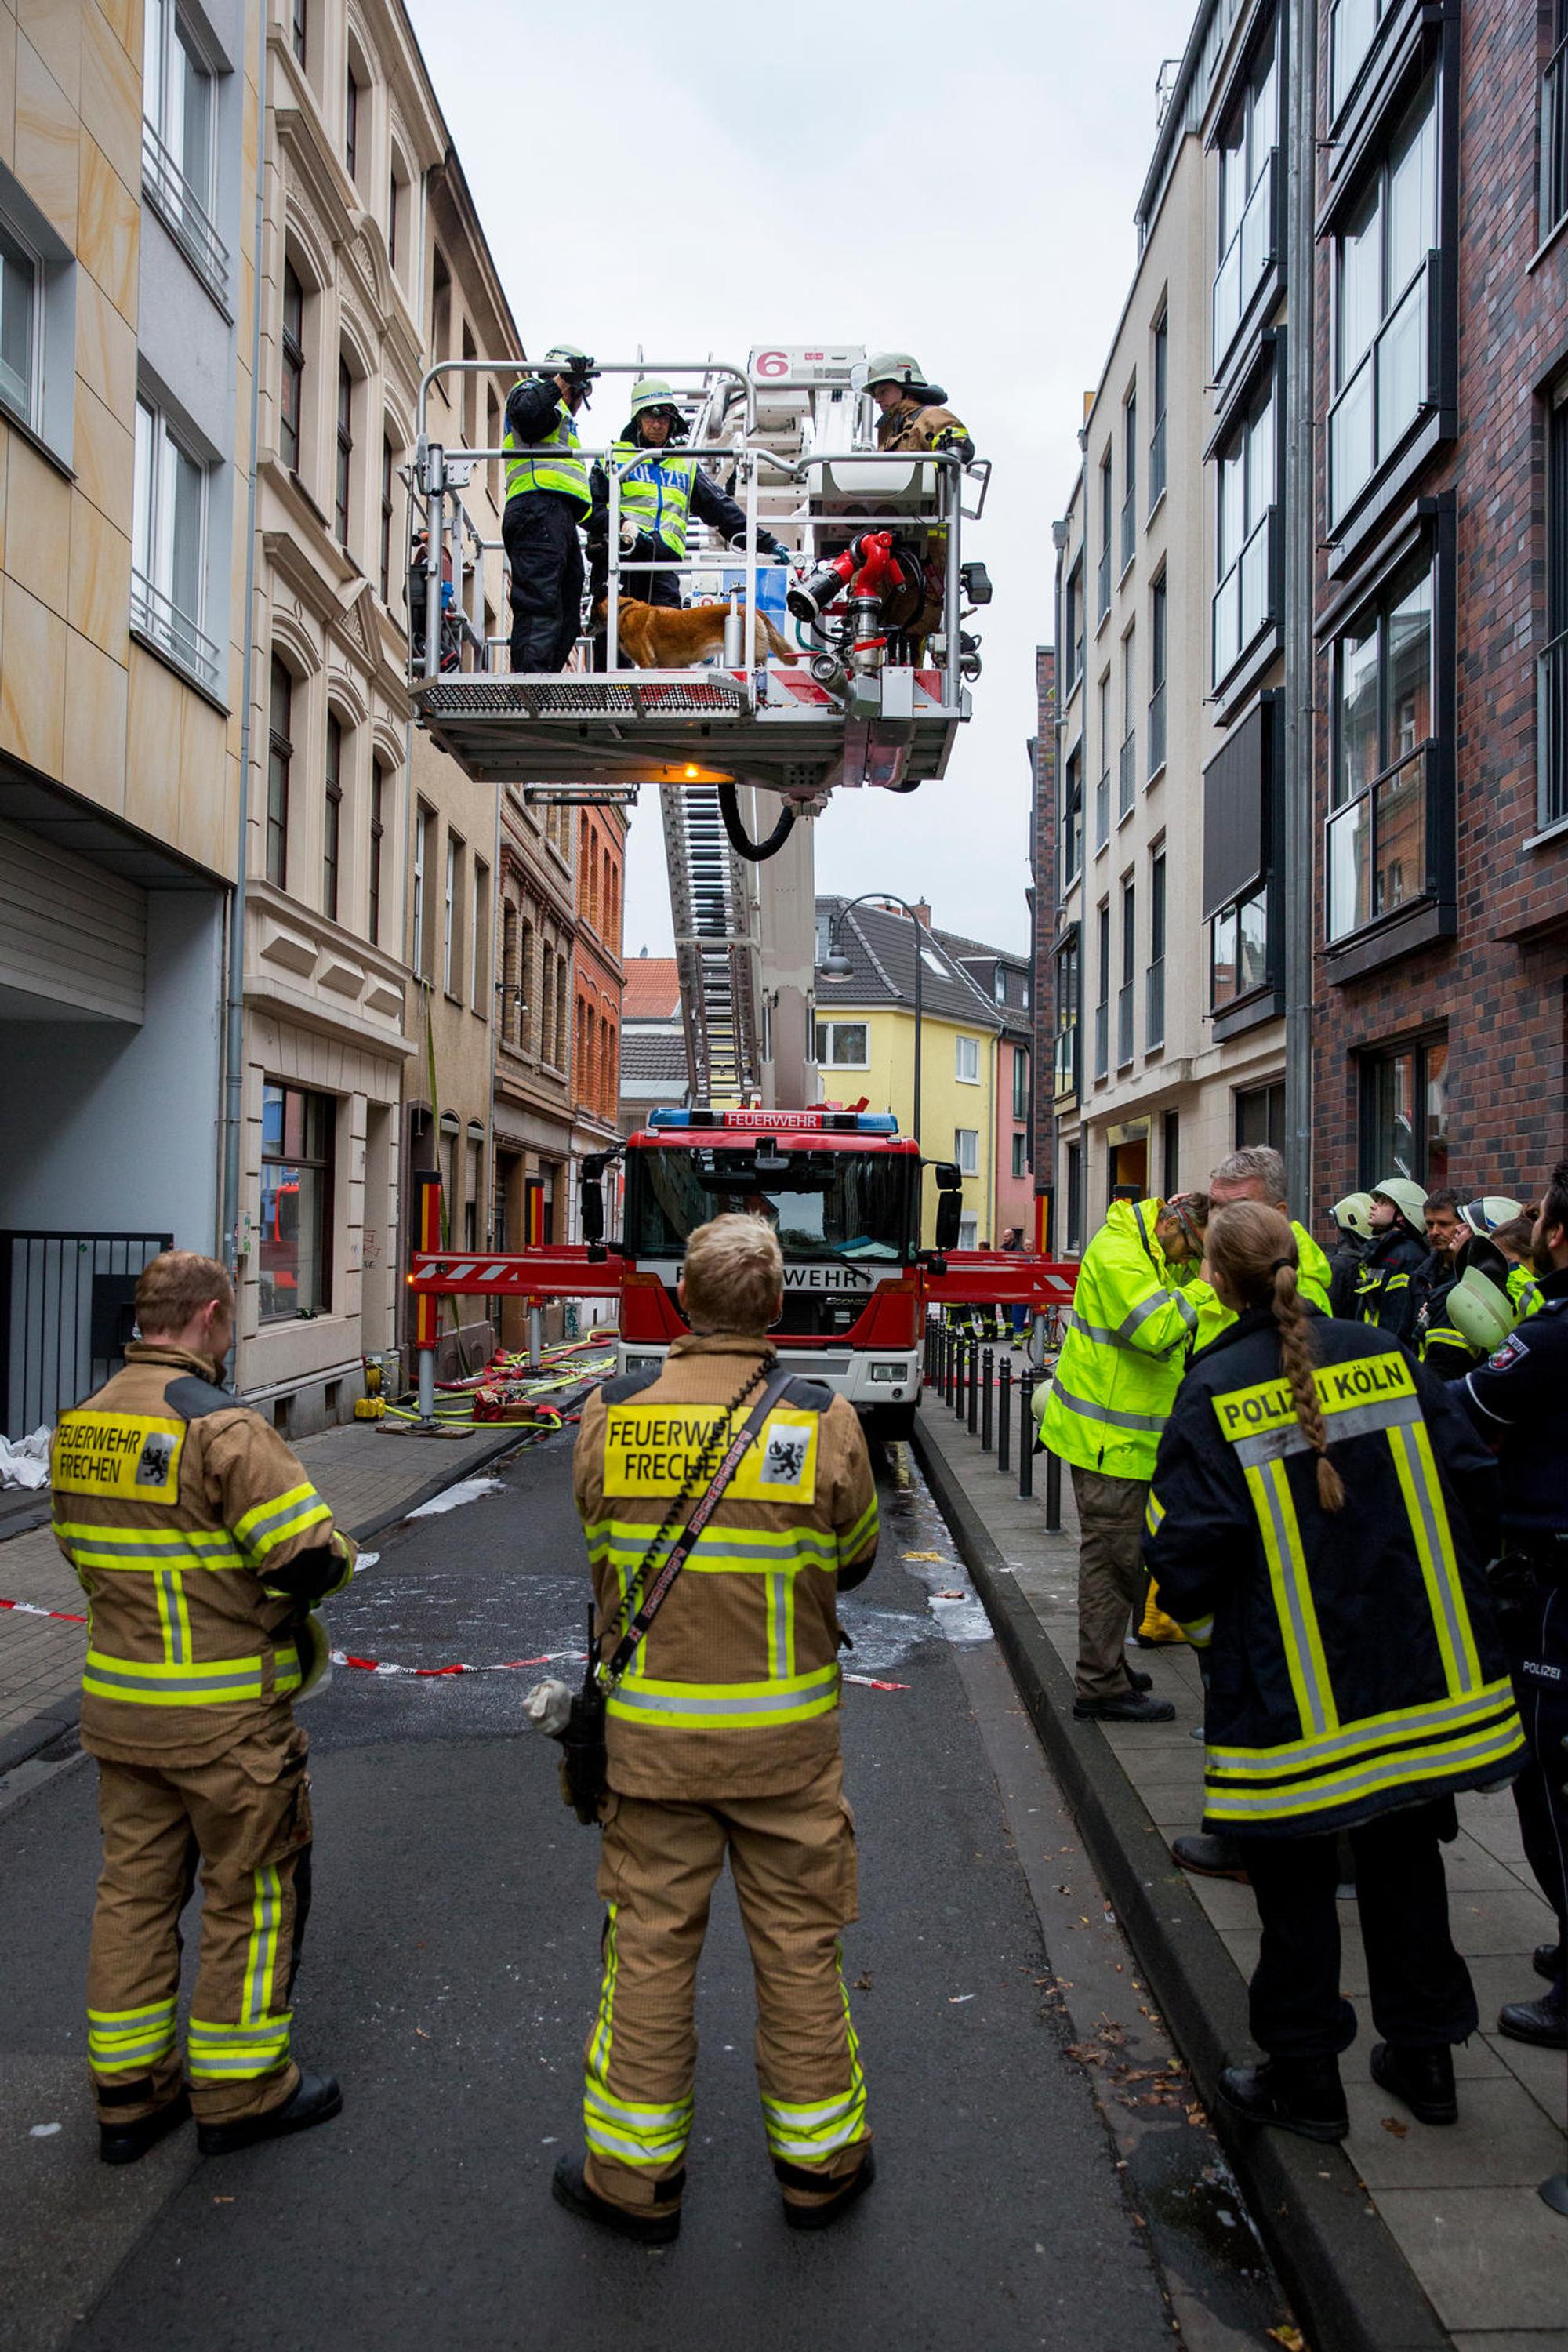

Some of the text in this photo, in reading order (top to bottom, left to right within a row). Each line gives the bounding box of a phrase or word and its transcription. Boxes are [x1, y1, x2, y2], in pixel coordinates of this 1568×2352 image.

[757, 352, 789, 377] 6
[626, 463, 687, 493] OLIZEI
[728, 1113, 817, 1127] FEUERWEHR
[676, 1266, 858, 1287] FWEHR
[1224, 1363, 1405, 1428] POLIZI KÖLN
[59, 1424, 141, 1454] FEUERWEHR
[608, 1421, 760, 1449] FEUERWEH
[60, 1454, 122, 1483] FRECHEN
[1523, 1661, 1560, 1679] POLIZEI
